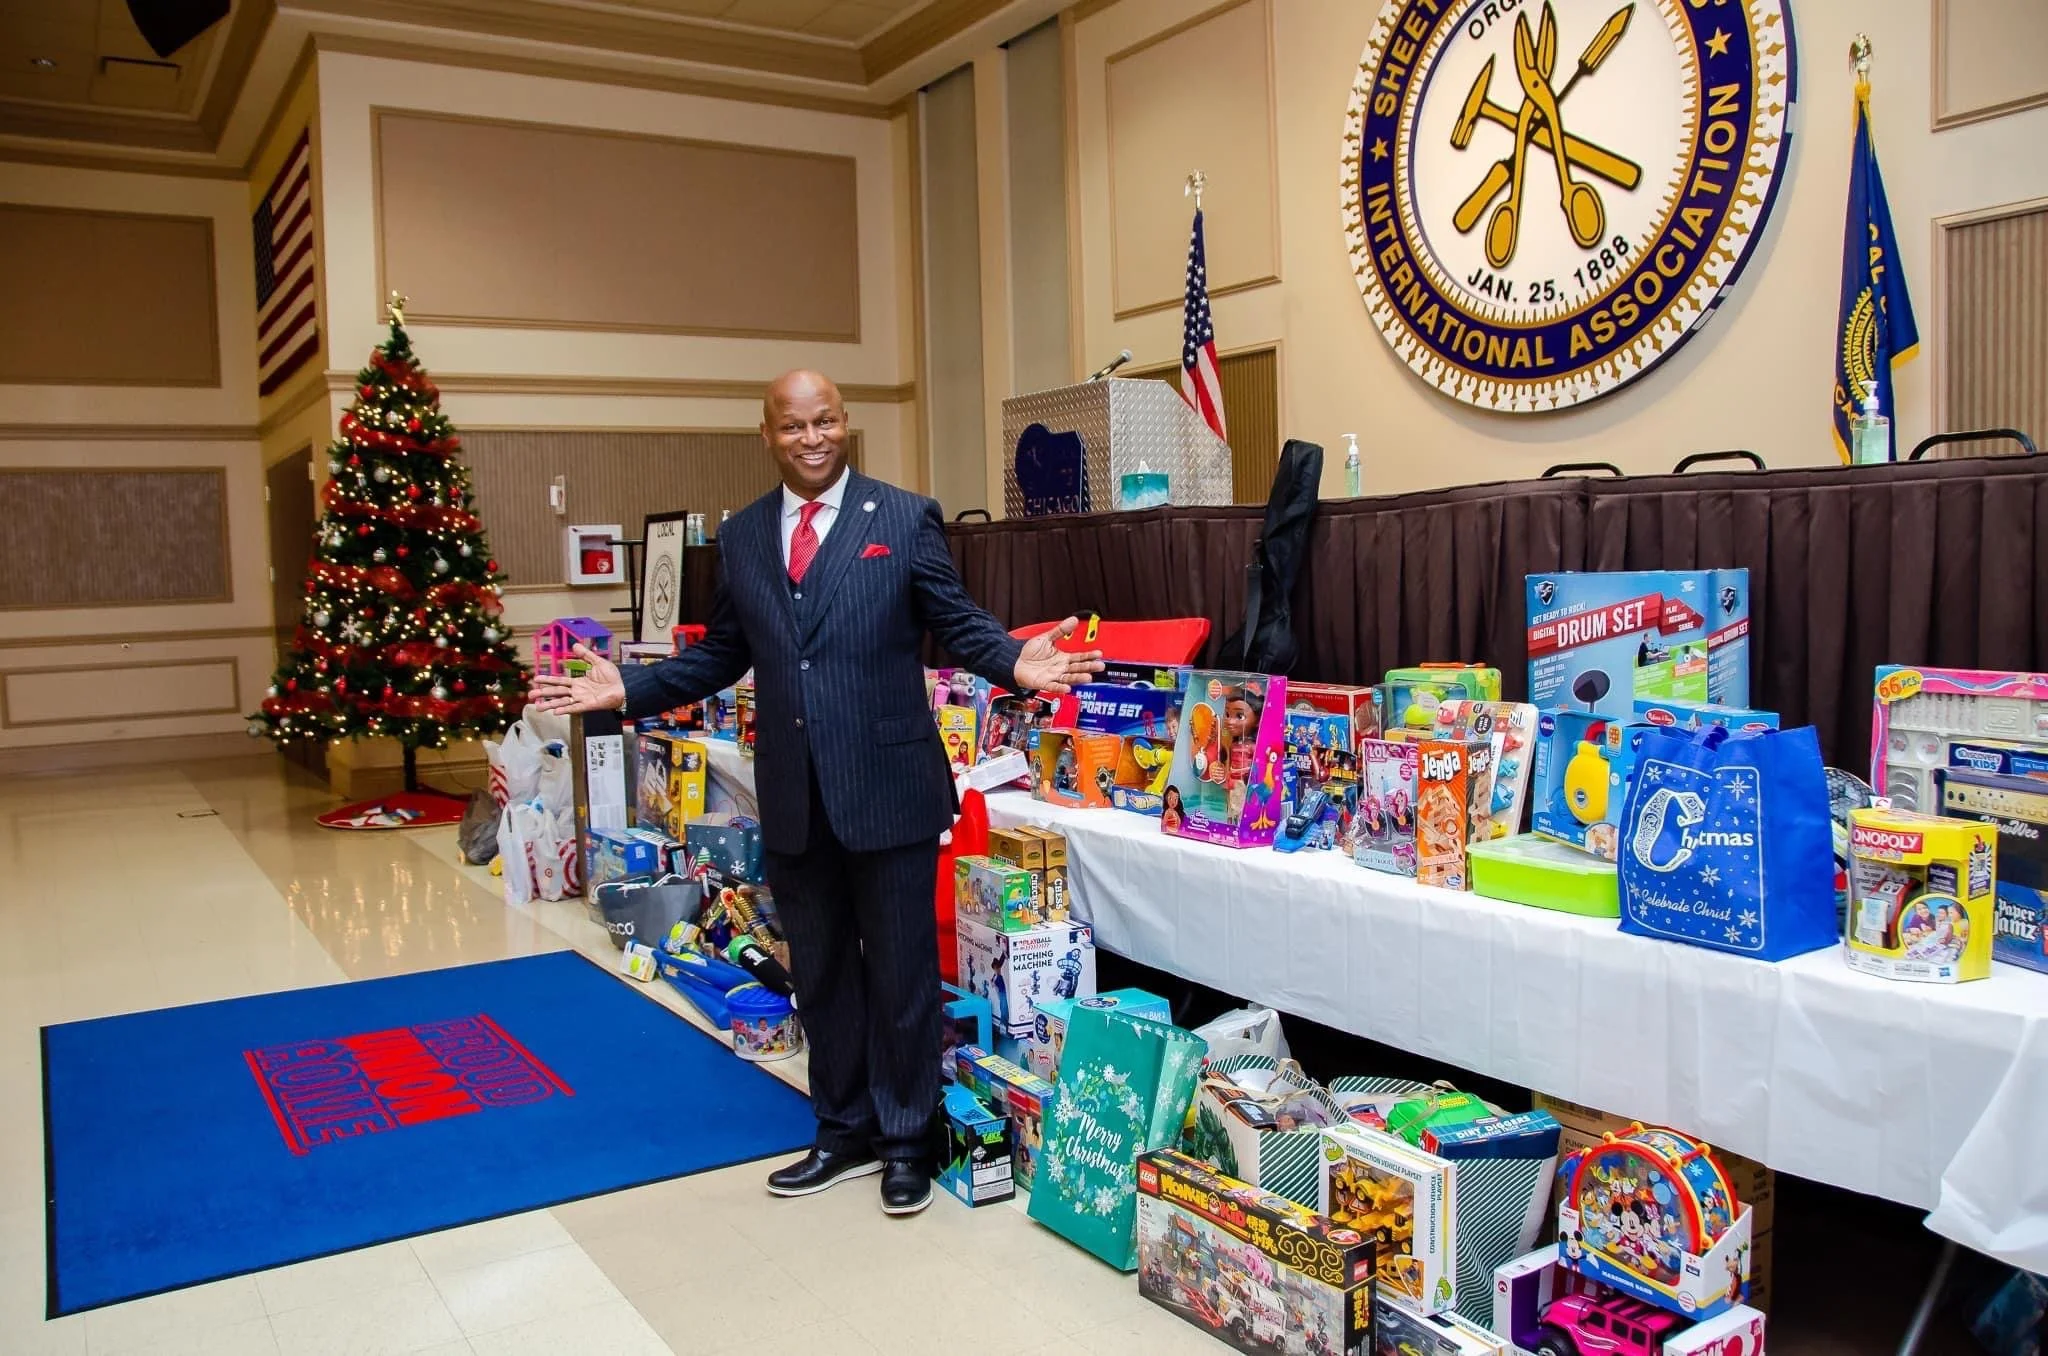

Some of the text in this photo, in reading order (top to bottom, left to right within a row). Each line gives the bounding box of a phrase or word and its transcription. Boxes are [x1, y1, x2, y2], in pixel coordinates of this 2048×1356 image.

[1367, 81, 1740, 368] INTERNATIONAL ASSOCIATION
[1467, 235, 1630, 303] JAN. 25, 1888
[1026, 495, 1080, 516] CHICAGO
[1532, 615, 1543, 625] GET
[1543, 609, 1560, 621] READY
[1533, 600, 1645, 648] DIGITAL DRUM SET
[1879, 676, 1901, 699] 66
[1079, 701, 1143, 718] PORTS SET
[1421, 750, 1462, 781] Jenga
[1467, 749, 1491, 775] Jenga
[1971, 758, 1998, 770] KIDS
[1853, 828, 1919, 850] ONOPOLY
[1054, 878, 1064, 910] CHESS
[1641, 888, 1732, 921] Celebrate Christ
[1998, 897, 2037, 922] Paper
[1012, 950, 1054, 963] PITCHING
[1012, 959, 1053, 972] MACHINE
[416, 1014, 555, 1107] PROUD
[336, 1028, 483, 1125] UNION
[255, 1038, 396, 1147] HOME
[1079, 1112, 1122, 1154] Merry
[1456, 1127, 1480, 1139] DIRT
[1484, 1114, 1531, 1131] DIGGERS
[1066, 1136, 1130, 1181] Christmas
[1346, 1144, 1422, 1181] CONSTRUCTION VEHICLE PLAYSET
[1140, 1170, 1156, 1185] LEGO
[1160, 1173, 1209, 1210] MONKIE
